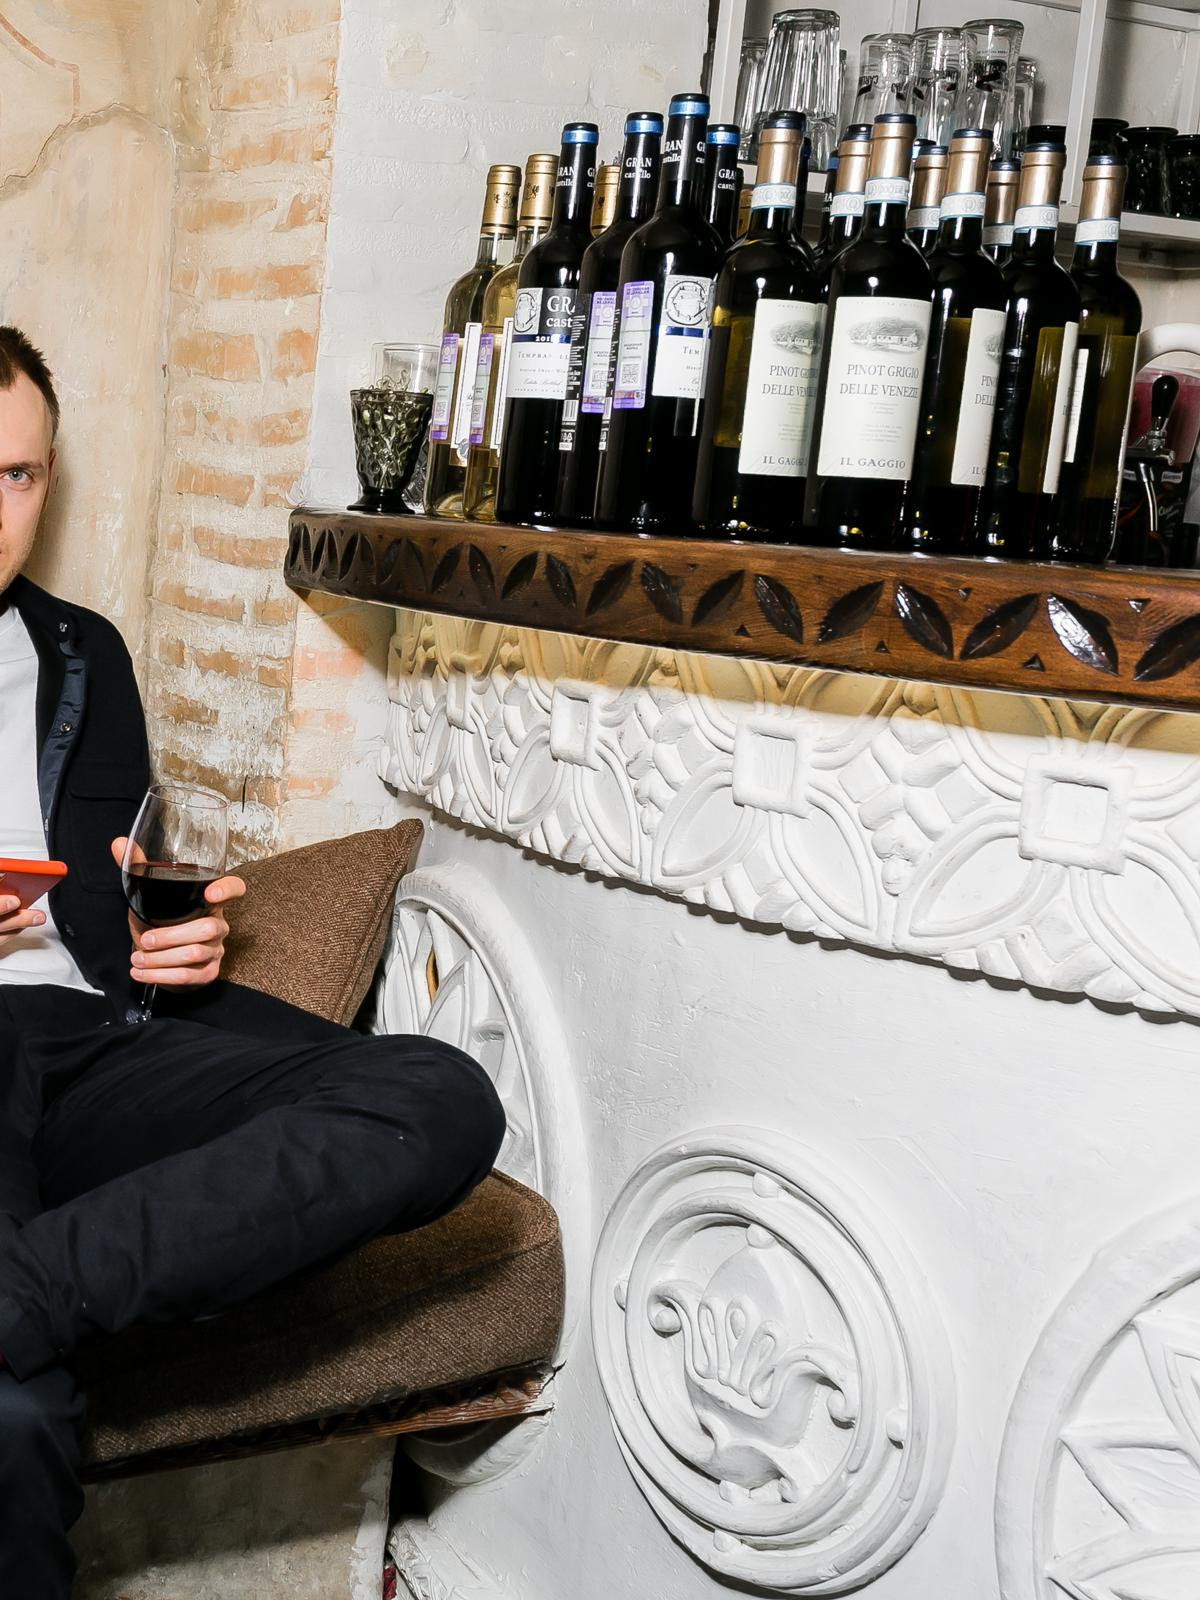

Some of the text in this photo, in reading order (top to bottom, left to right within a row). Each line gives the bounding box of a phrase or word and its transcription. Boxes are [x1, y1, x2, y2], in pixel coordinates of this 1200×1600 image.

[626, 157, 652, 167] GRAN
[625, 168, 651, 178] casillo
[719, 168, 736, 180] GRA
[546, 317, 572, 327] cast
[769, 364, 800, 378] PINOT
[847, 363, 920, 379] PINOT GRIGIO
[762, 383, 795, 396] DELLE
[840, 383, 879, 396] DELLE
[763, 455, 776, 465] IL
[840, 456, 906, 470] IL GAGGIO
